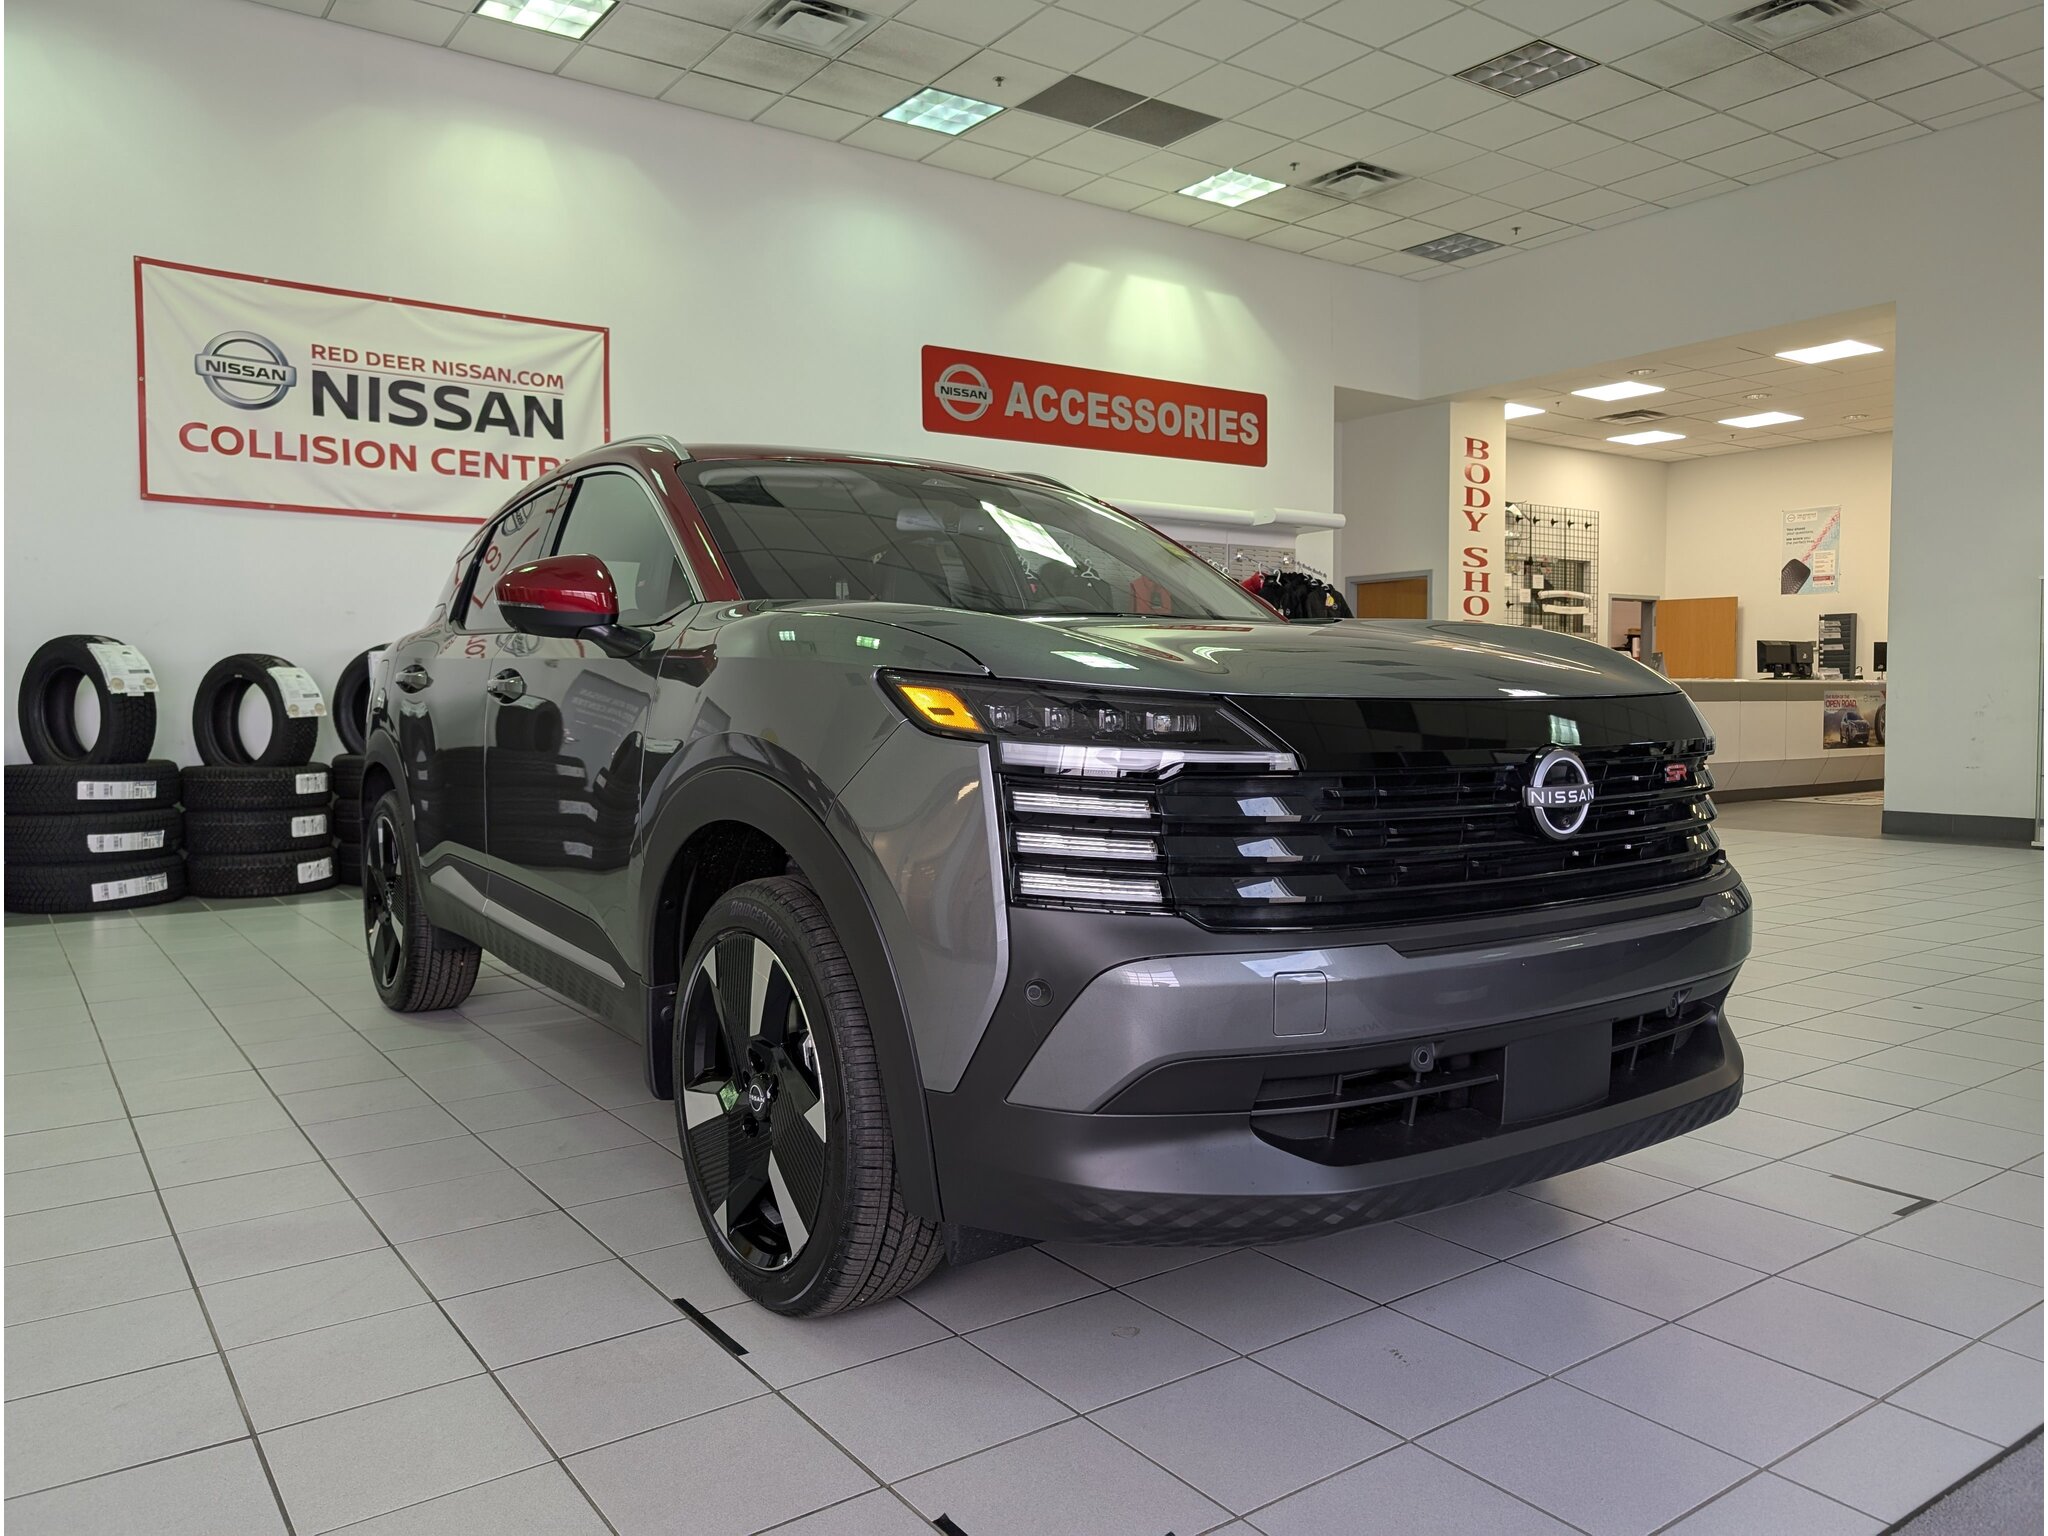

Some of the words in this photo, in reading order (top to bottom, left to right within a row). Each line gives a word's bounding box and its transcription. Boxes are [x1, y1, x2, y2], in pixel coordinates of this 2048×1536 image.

[204, 359, 287, 382] NISSAN
[311, 343, 358, 364] RED
[366, 351, 425, 373] DEER
[432, 359, 564, 390] NISSAN.COM
[940, 384, 988, 401] NISSAN
[311, 370, 565, 440] NISSAN
[1004, 381, 1259, 446] ACCESSORIES
[179, 422, 417, 473] COLLISION
[430, 447, 572, 482] CENTR
[1462, 436, 1491, 532] BODY
[1462, 547, 1491, 622] SHO
[1530, 786, 1595, 804] NISSAN
[729, 900, 789, 945] BRIDGESTONE
